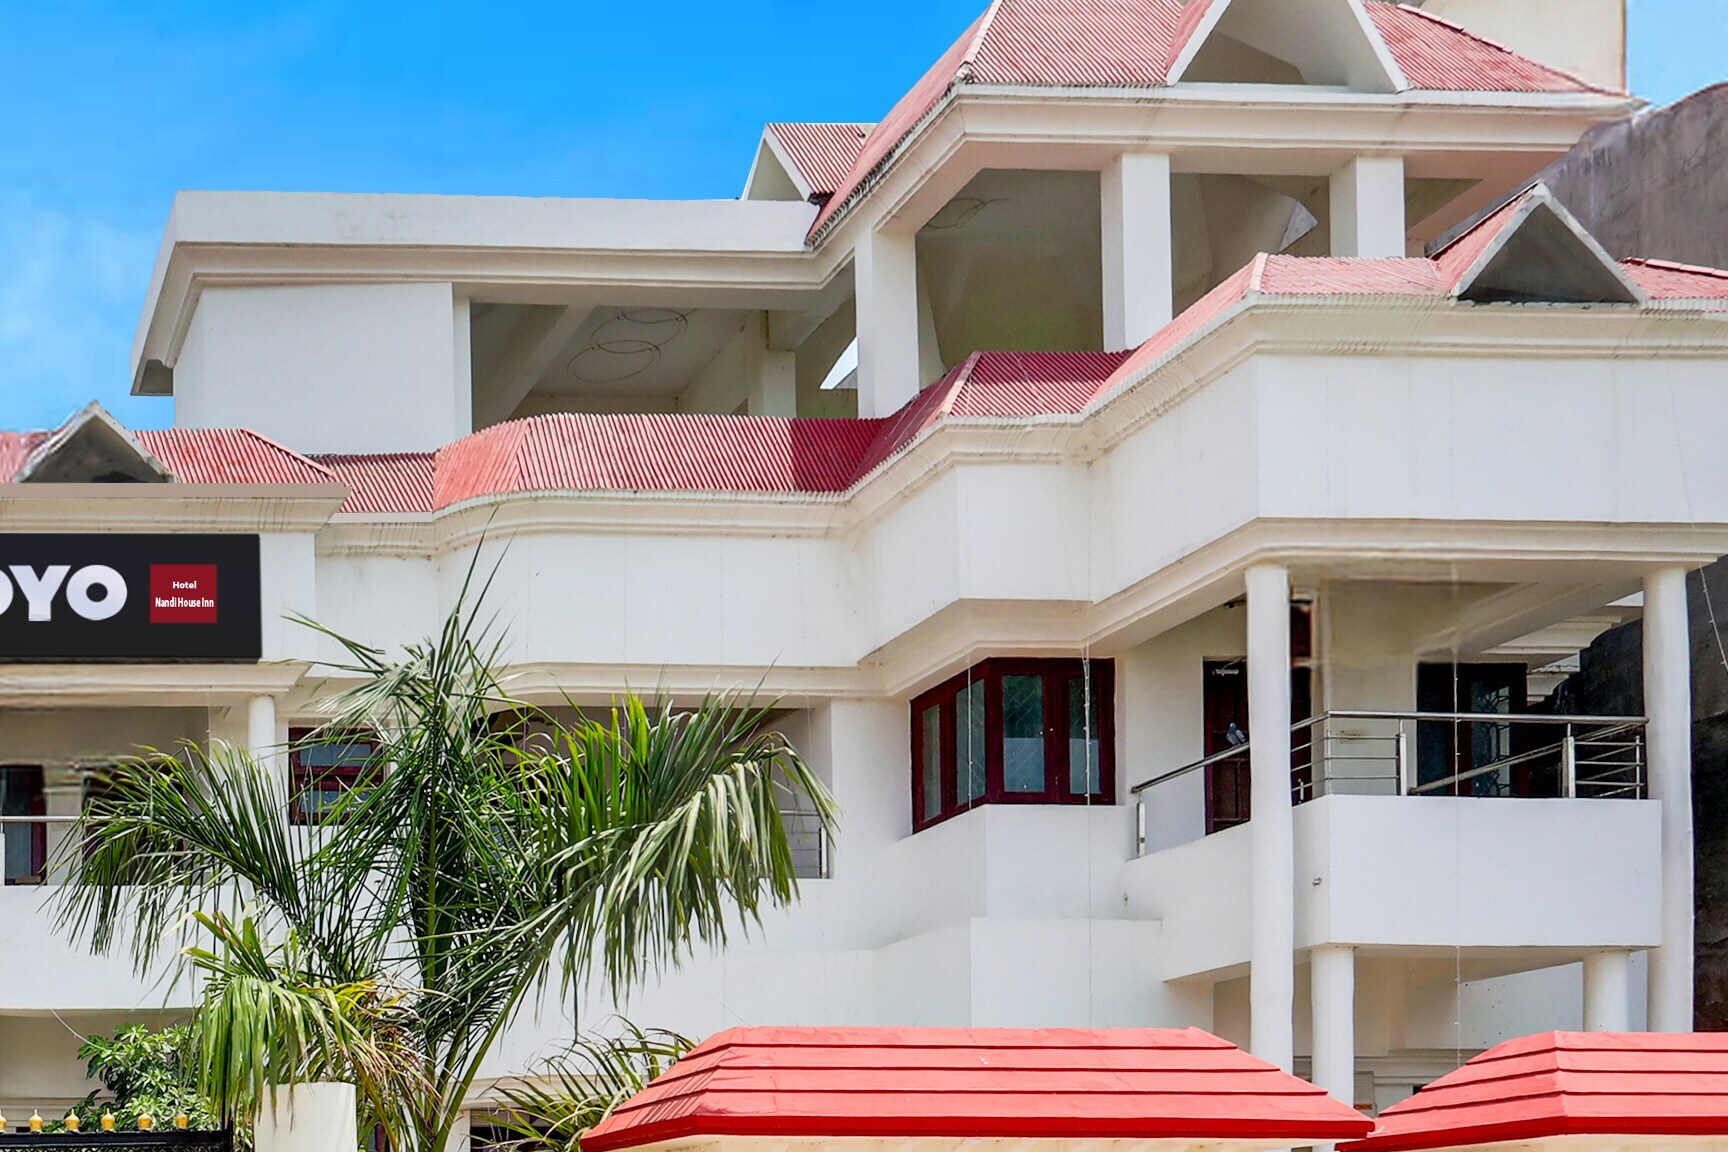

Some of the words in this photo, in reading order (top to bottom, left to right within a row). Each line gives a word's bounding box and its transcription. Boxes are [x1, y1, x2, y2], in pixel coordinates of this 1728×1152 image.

[172, 580, 197, 589] Hotel
[155, 596, 177, 608] Nandi
[177, 596, 201, 608] House
[201, 596, 215, 608] Inn
